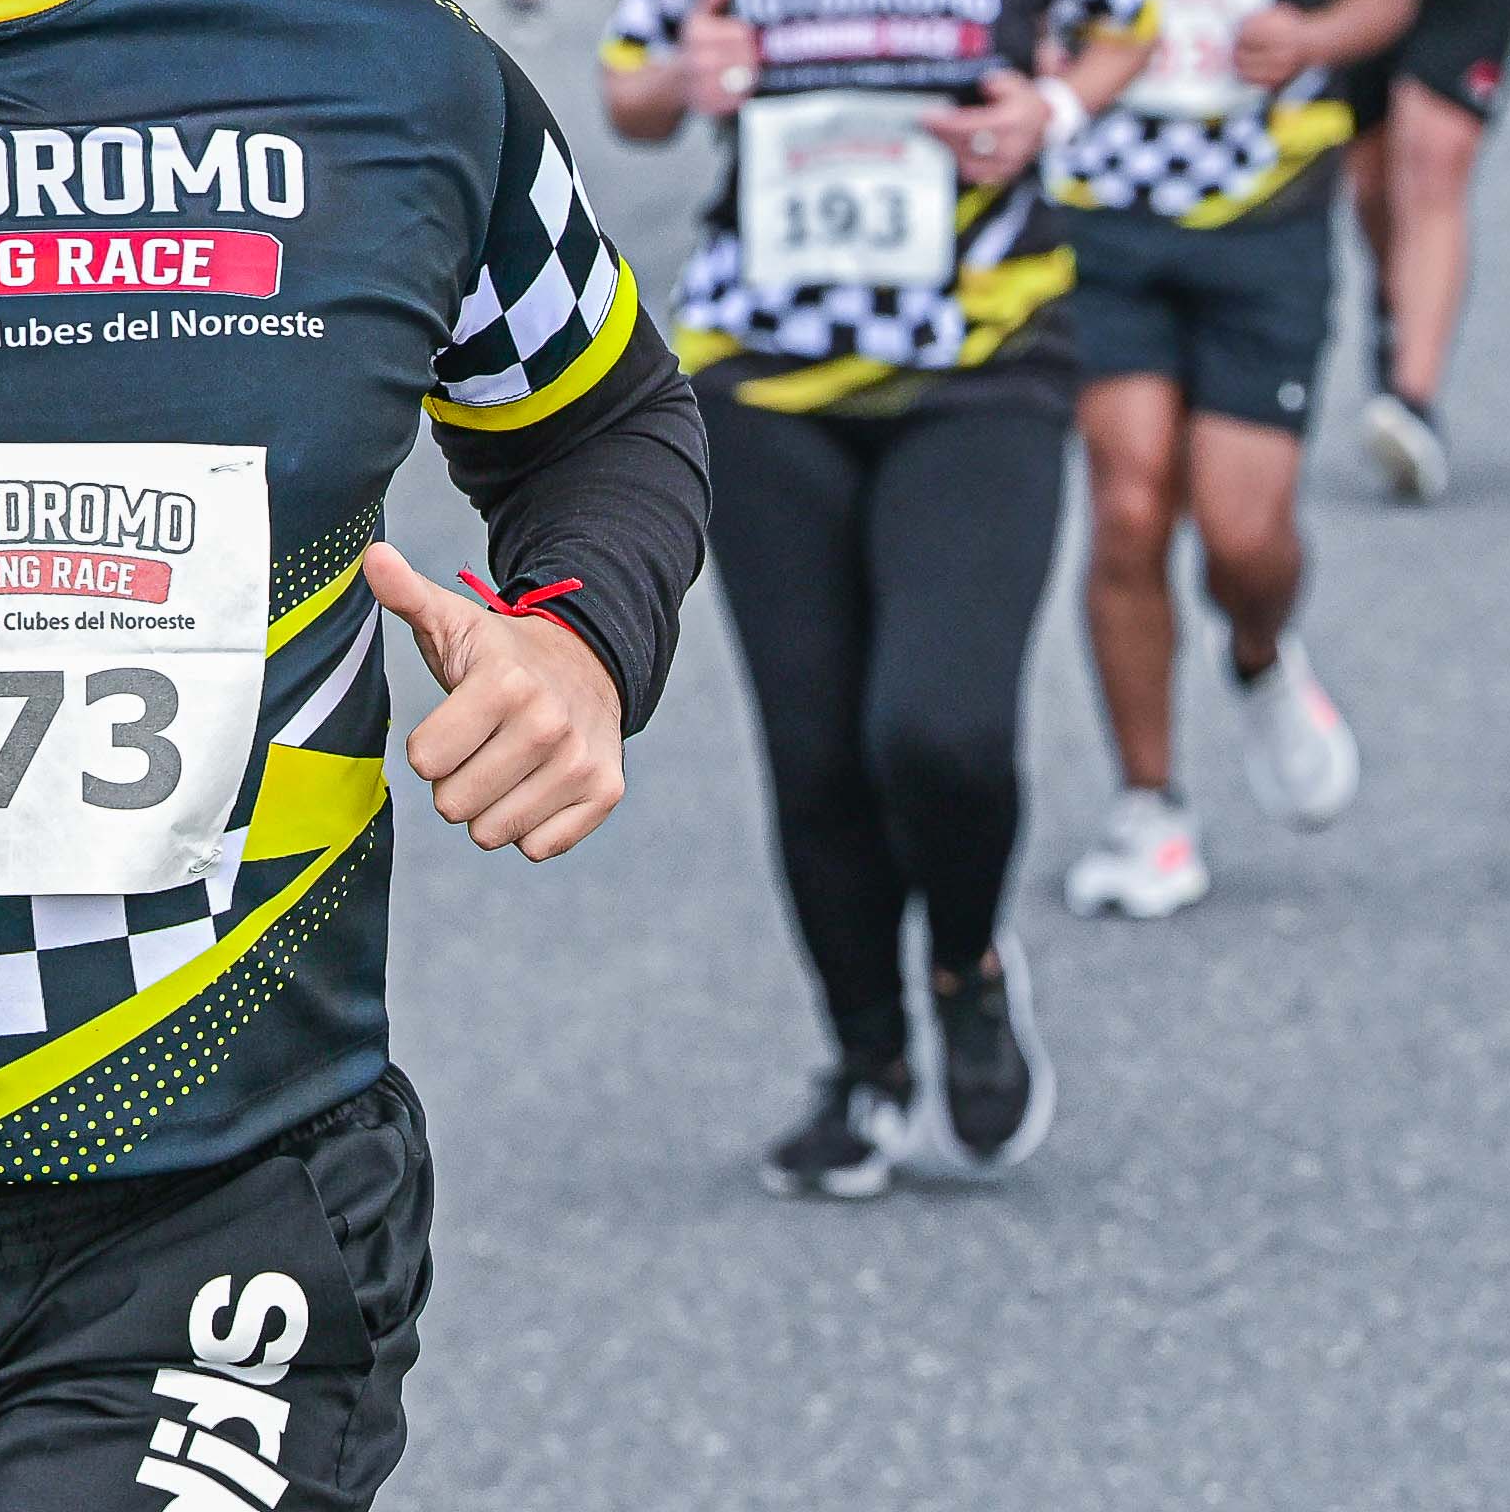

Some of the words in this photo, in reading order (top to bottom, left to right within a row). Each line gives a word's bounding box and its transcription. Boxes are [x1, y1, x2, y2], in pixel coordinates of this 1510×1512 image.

[783, 185, 908, 249] 193
[56, 238, 215, 288] RACE
[102, 310, 159, 344] del
[171, 309, 326, 339] Noroeste
[50, 555, 137, 596] RACE
[3, 610, 70, 631] Clubes
[74, 610, 105, 631] del
[110, 611, 196, 631] Noroeste
